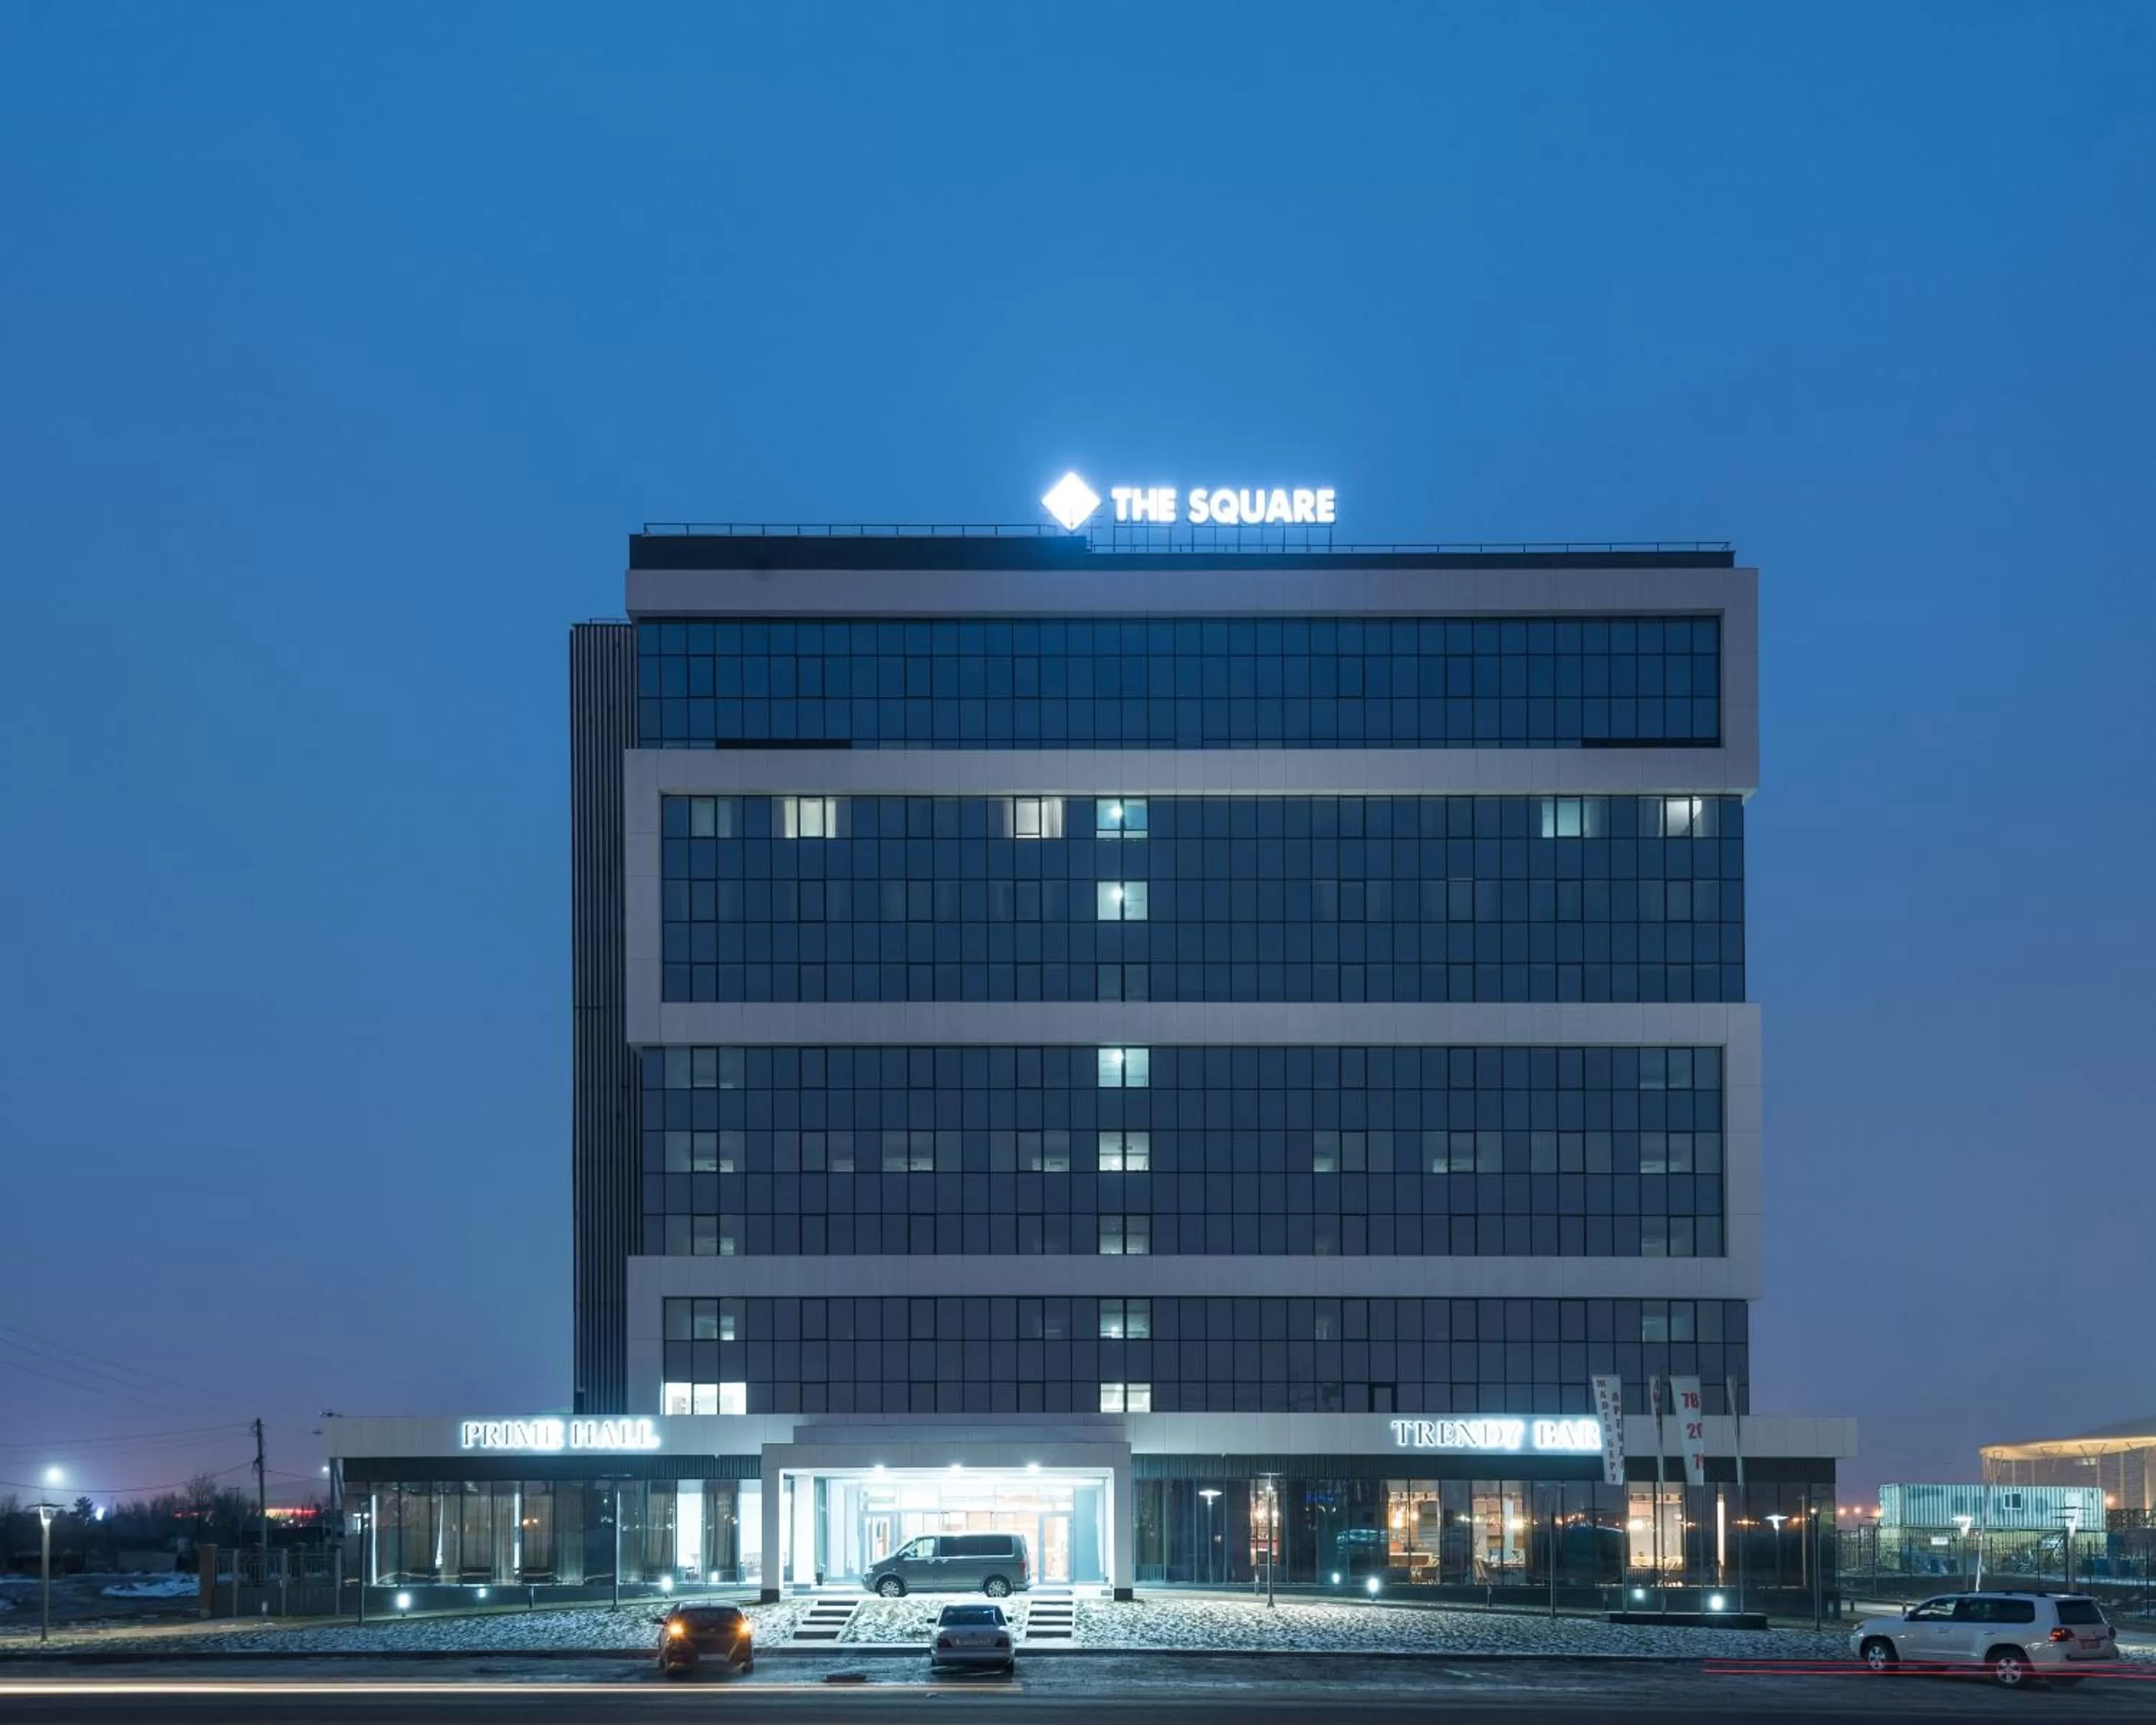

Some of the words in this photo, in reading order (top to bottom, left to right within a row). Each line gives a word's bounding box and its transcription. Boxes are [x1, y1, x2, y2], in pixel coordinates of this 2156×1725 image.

[1110, 487, 1177, 523] THE
[1187, 487, 1335, 525] SQUARE
[463, 1420, 563, 1447] PRIME
[572, 1420, 660, 1448] HALL
[1392, 1420, 1523, 1448] TRENDY
[1536, 1420, 1602, 1449] BAR
